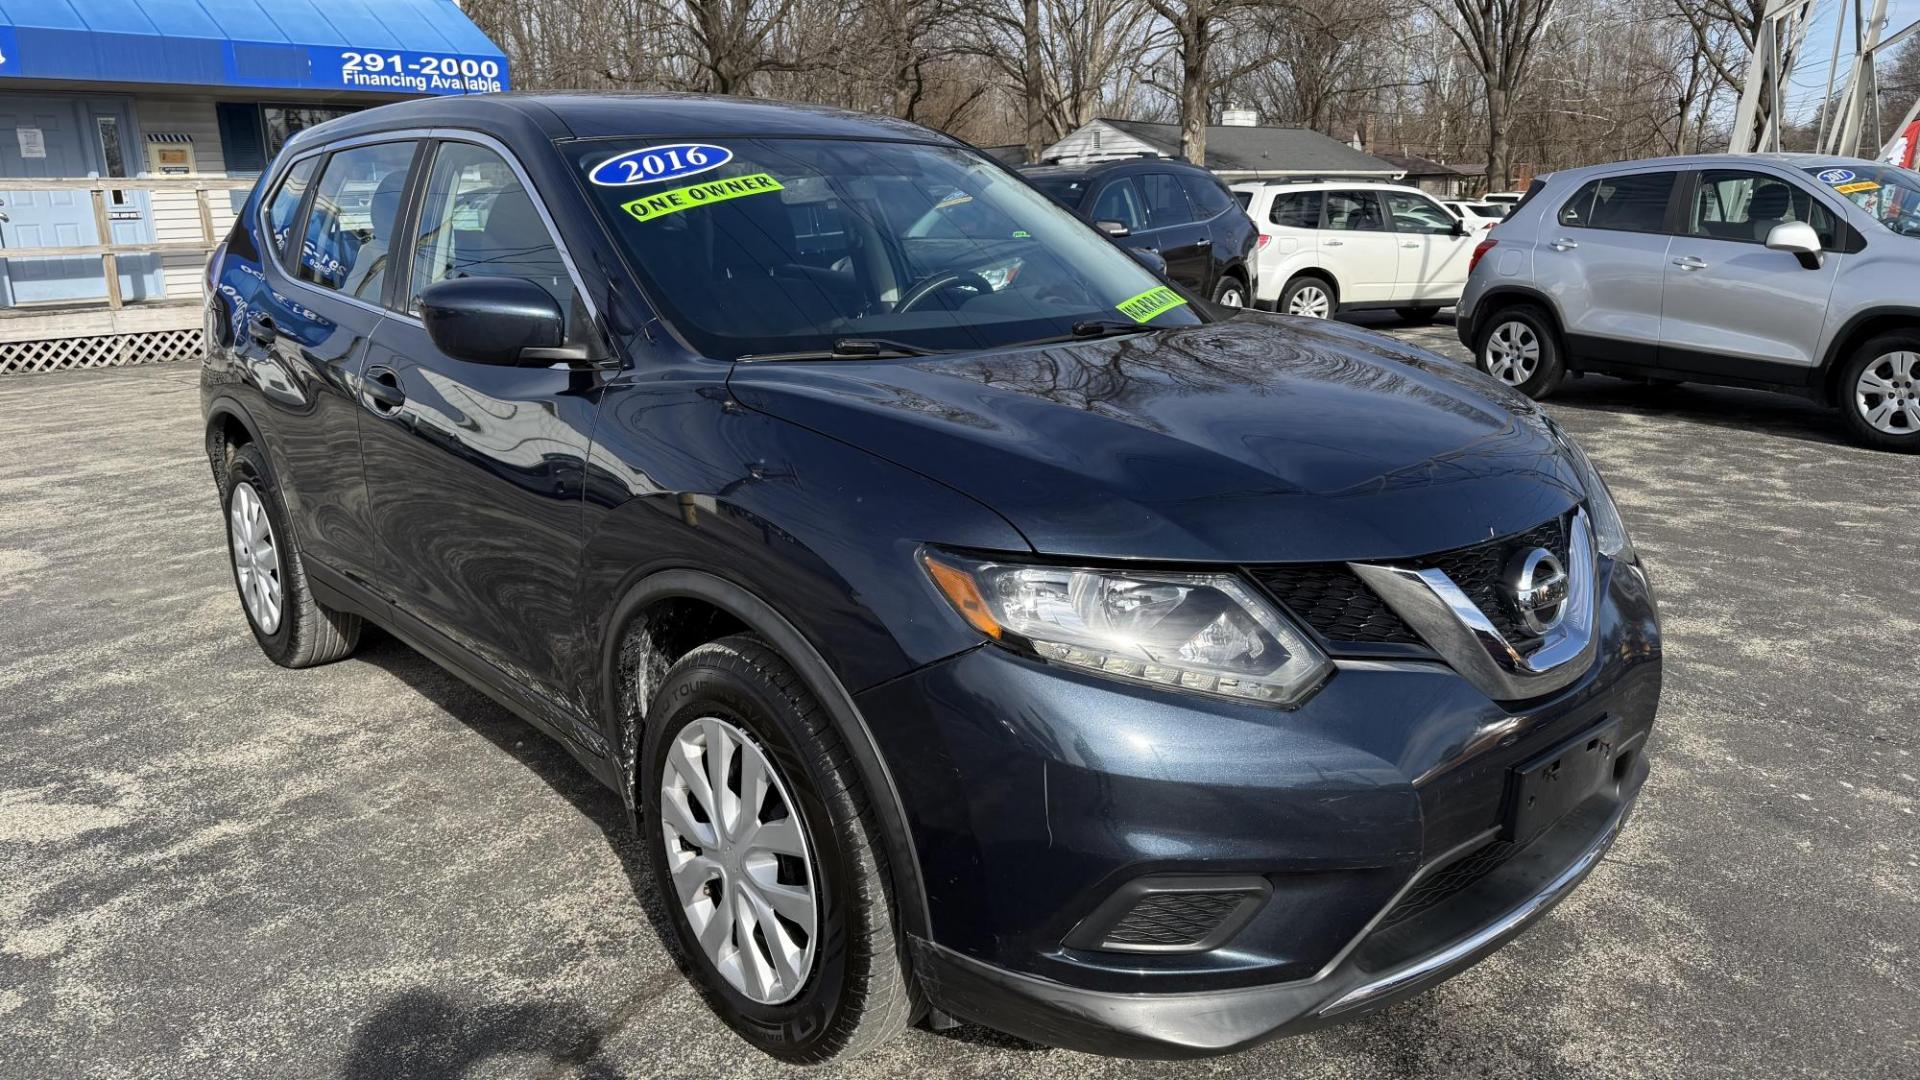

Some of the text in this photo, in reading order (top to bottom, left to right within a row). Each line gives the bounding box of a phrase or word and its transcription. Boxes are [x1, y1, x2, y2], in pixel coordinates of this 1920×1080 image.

[341, 52, 499, 78] 291-2000
[342, 70, 427, 90] Financing
[619, 147, 708, 182] 2016
[630, 176, 774, 217] ONE OWNER
[1120, 289, 1181, 319] WARRANTY
